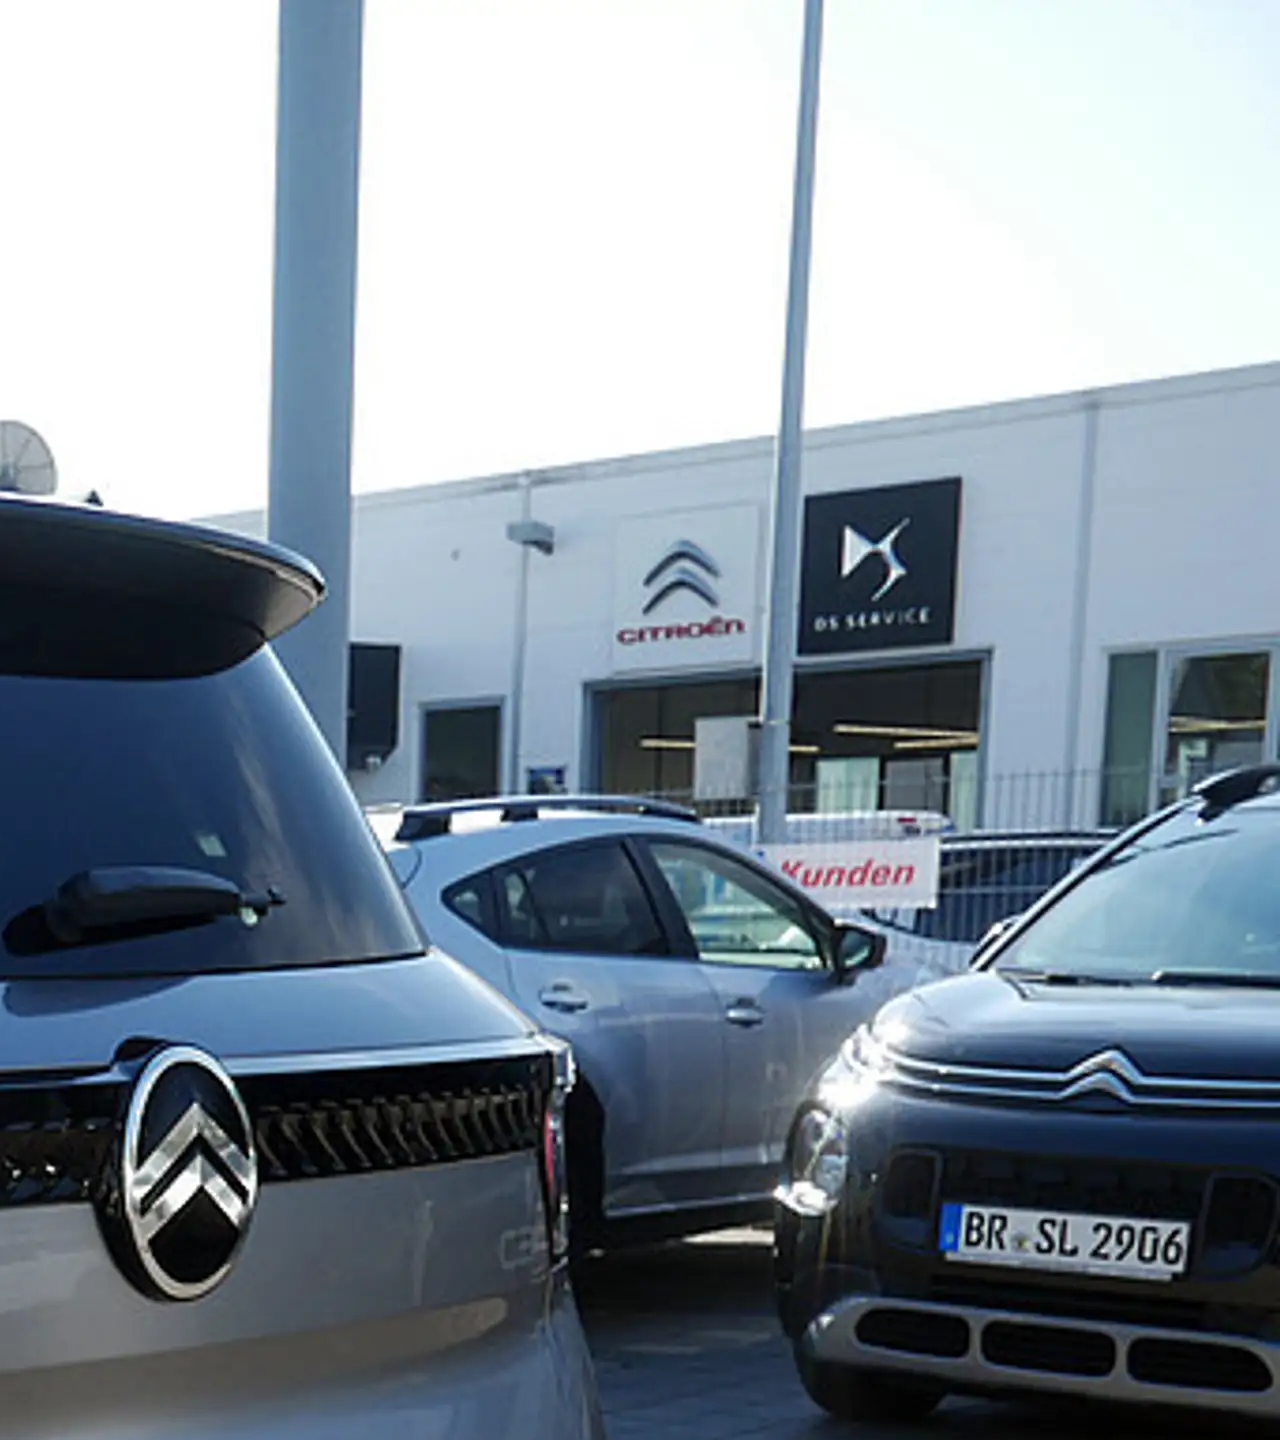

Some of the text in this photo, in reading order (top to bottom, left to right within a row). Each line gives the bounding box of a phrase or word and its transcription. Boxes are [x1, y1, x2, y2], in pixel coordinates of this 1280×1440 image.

[813, 605, 932, 633] DS SERVICE
[781, 857, 916, 888] Kunden
[963, 1210, 1184, 1266] BR SL 2906
